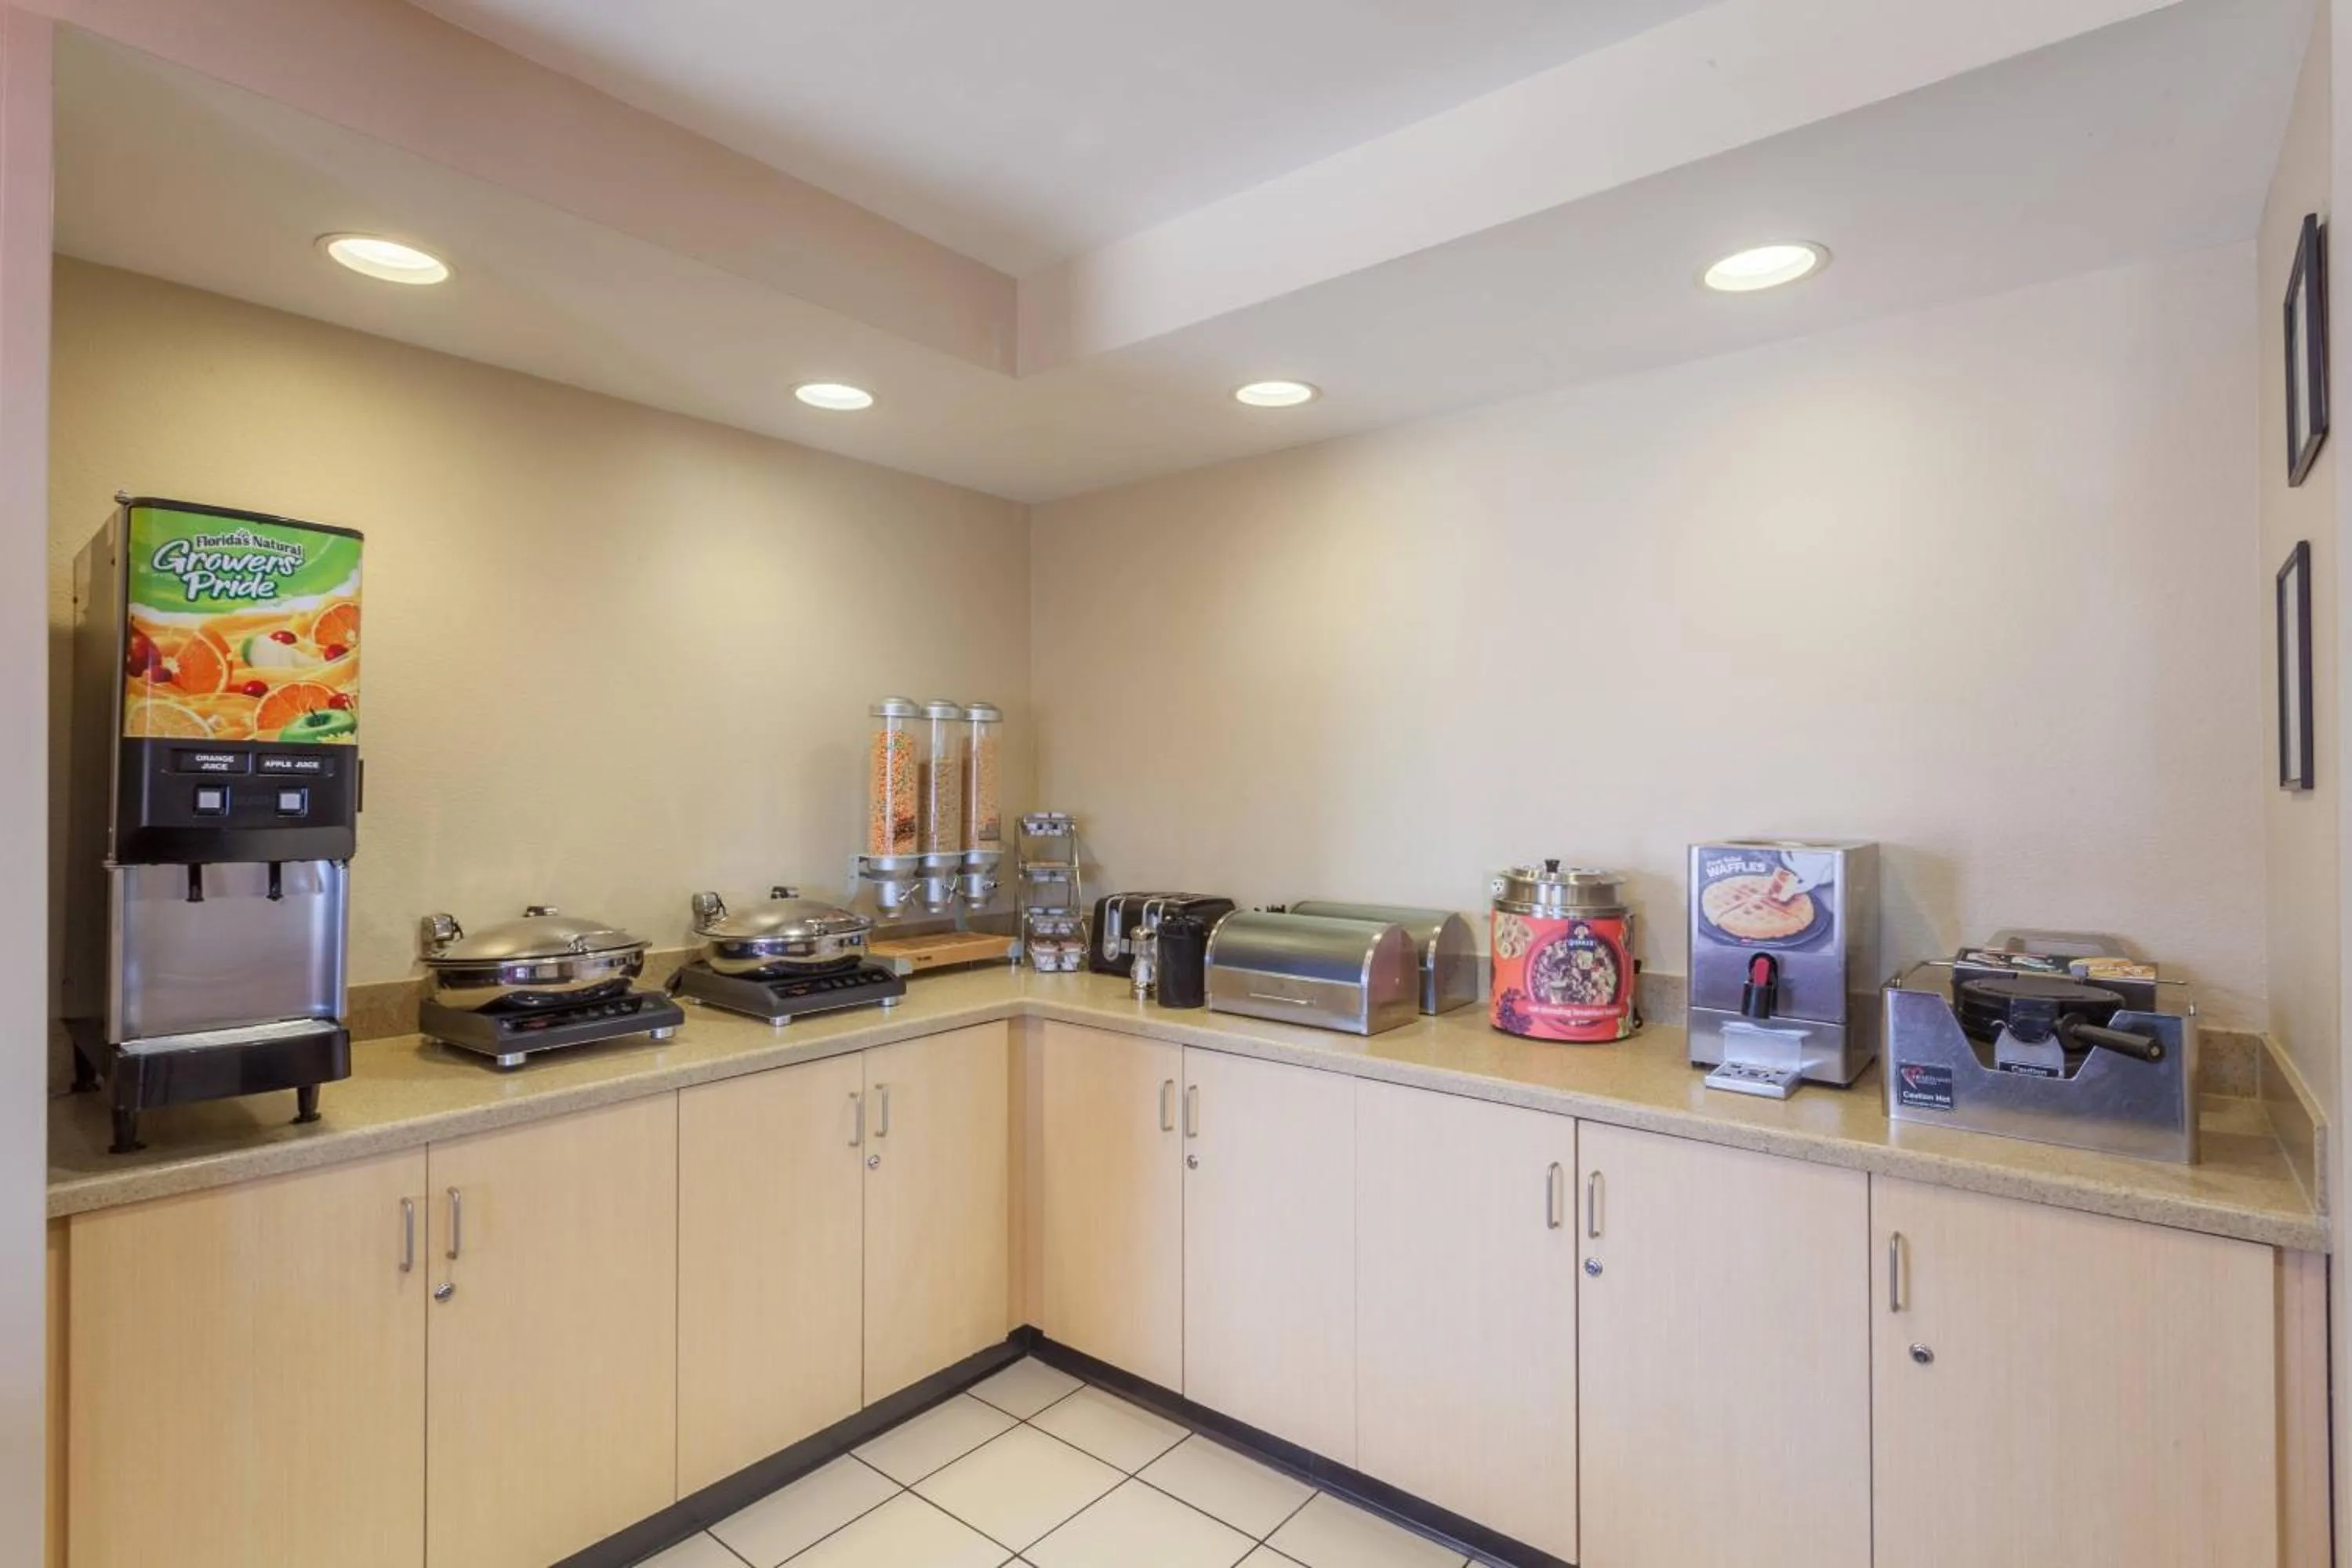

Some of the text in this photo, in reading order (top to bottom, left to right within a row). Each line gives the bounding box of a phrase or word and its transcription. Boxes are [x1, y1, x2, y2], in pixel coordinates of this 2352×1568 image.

[253, 536, 303, 556] Natural
[182, 570, 277, 601] Pride
[195, 754, 235, 763] ORANGE
[1705, 862, 1766, 877] WAFFLES
[1903, 1091, 1951, 1103] Caution Hot
